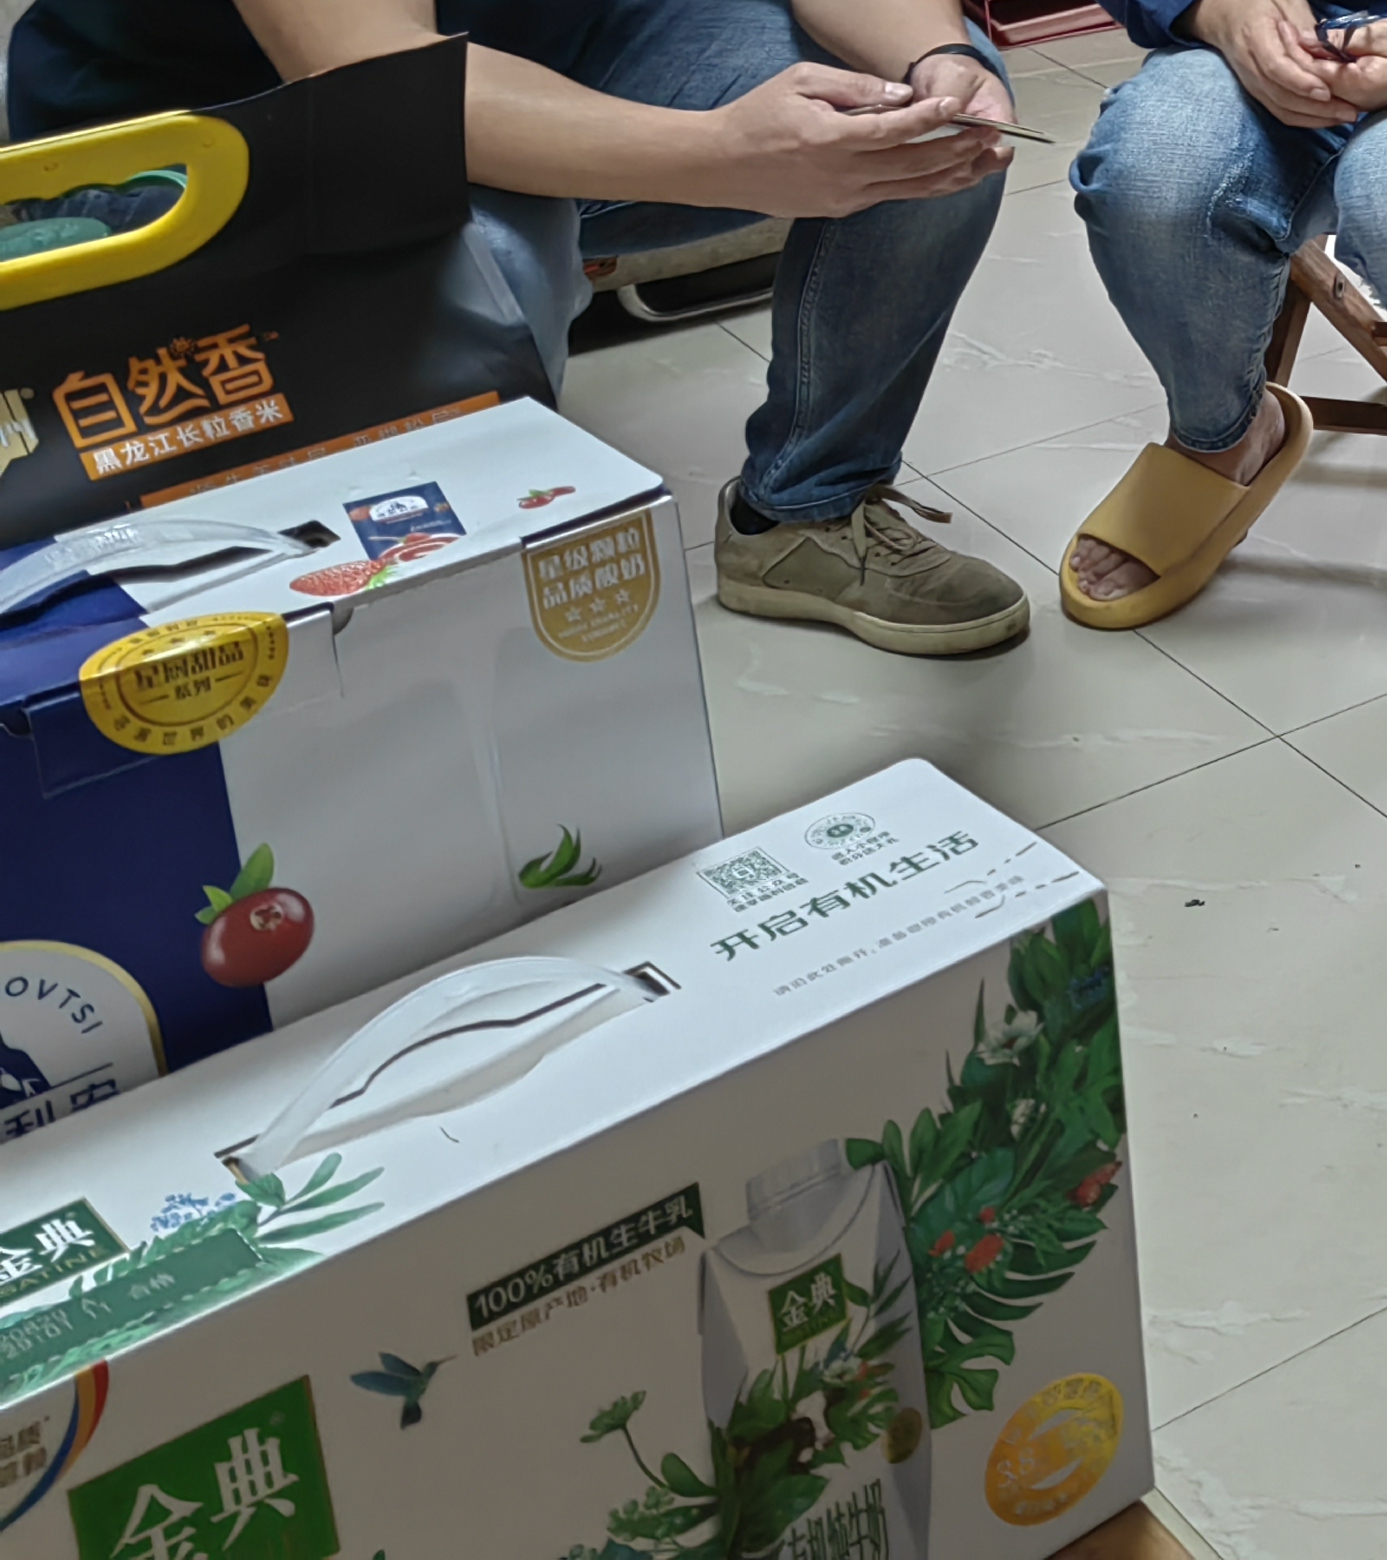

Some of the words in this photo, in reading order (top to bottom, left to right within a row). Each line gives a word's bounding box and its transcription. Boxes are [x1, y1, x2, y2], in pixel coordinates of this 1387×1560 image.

[53, 323, 275, 449] 自然香
[92, 399, 284, 475] 黑龙江长粒香米
[710, 830, 979, 961] 开启有机生活
[474, 1193, 693, 1319] 100%有机生牛乳
[780, 1271, 837, 1333] 金典
[110, 1427, 300, 1560] 金典
